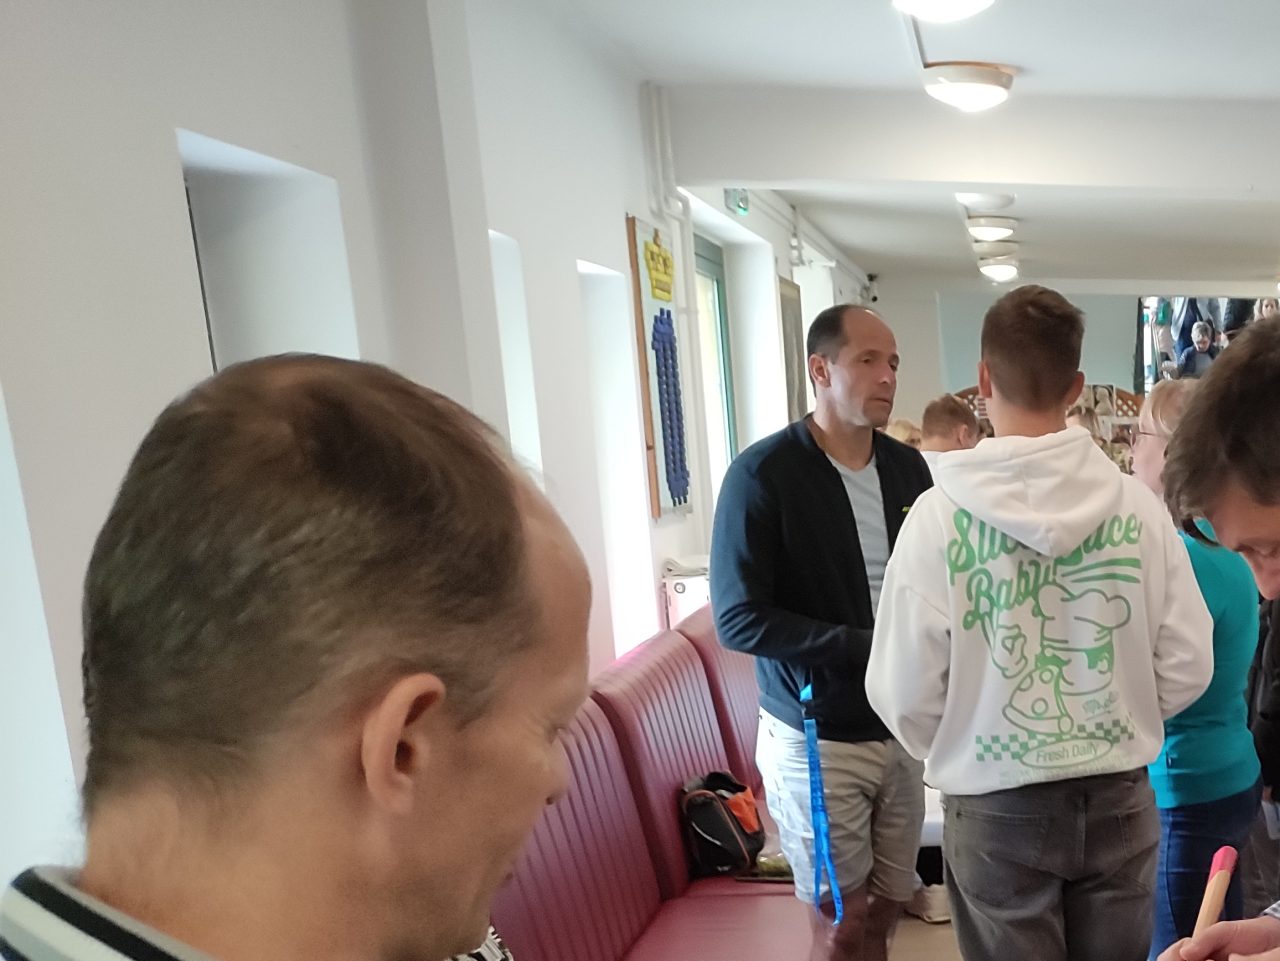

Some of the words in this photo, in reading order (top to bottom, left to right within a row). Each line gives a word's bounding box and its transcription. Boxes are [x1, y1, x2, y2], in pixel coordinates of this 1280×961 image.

[947, 508, 1030, 586] Slic
[1036, 746, 1070, 763] Fresh
[1072, 741, 1100, 758] Daily
